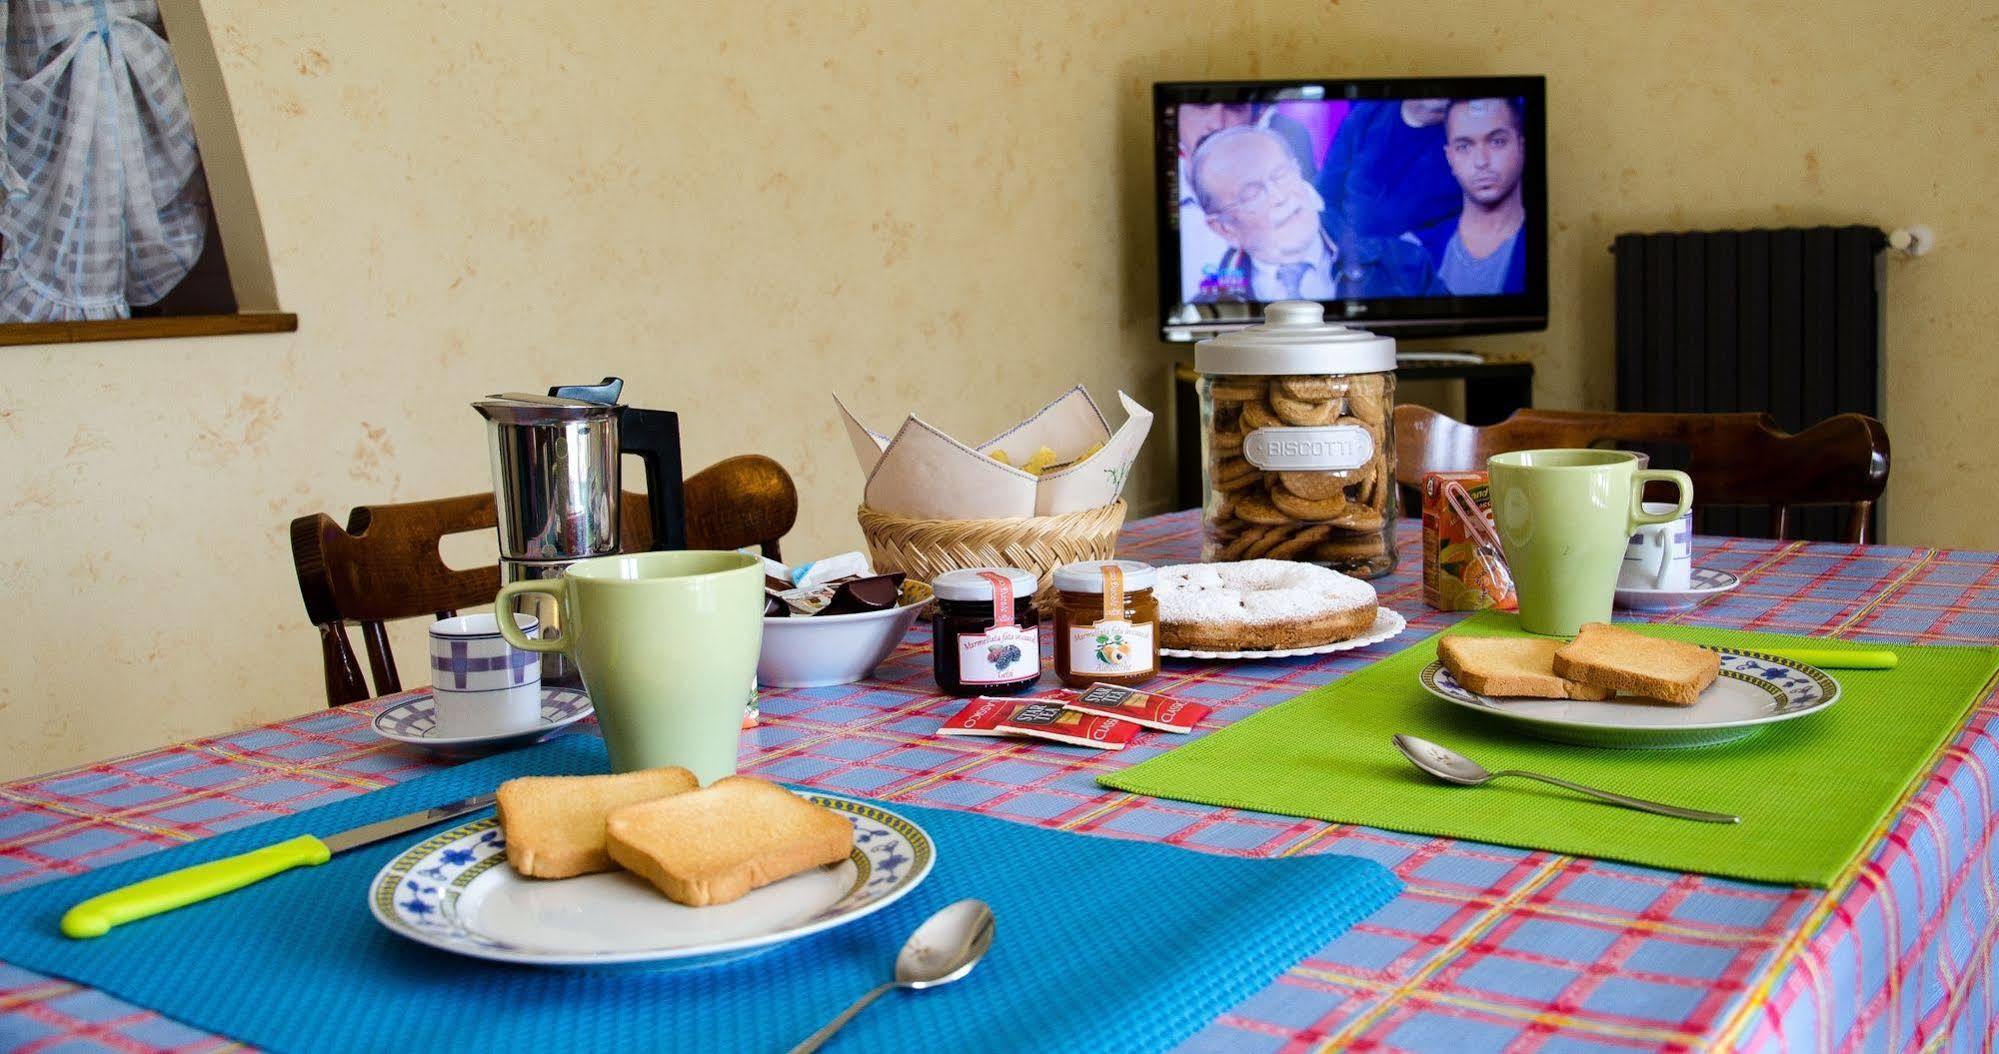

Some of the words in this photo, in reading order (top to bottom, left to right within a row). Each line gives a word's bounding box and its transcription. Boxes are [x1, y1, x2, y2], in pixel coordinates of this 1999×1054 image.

[1267, 439, 1354, 457] BISCOTTI
[1085, 687, 1112, 702] STAR
[1101, 691, 1126, 702] TEA
[1017, 704, 1047, 721] STAR
[1033, 708, 1061, 720] TEA
